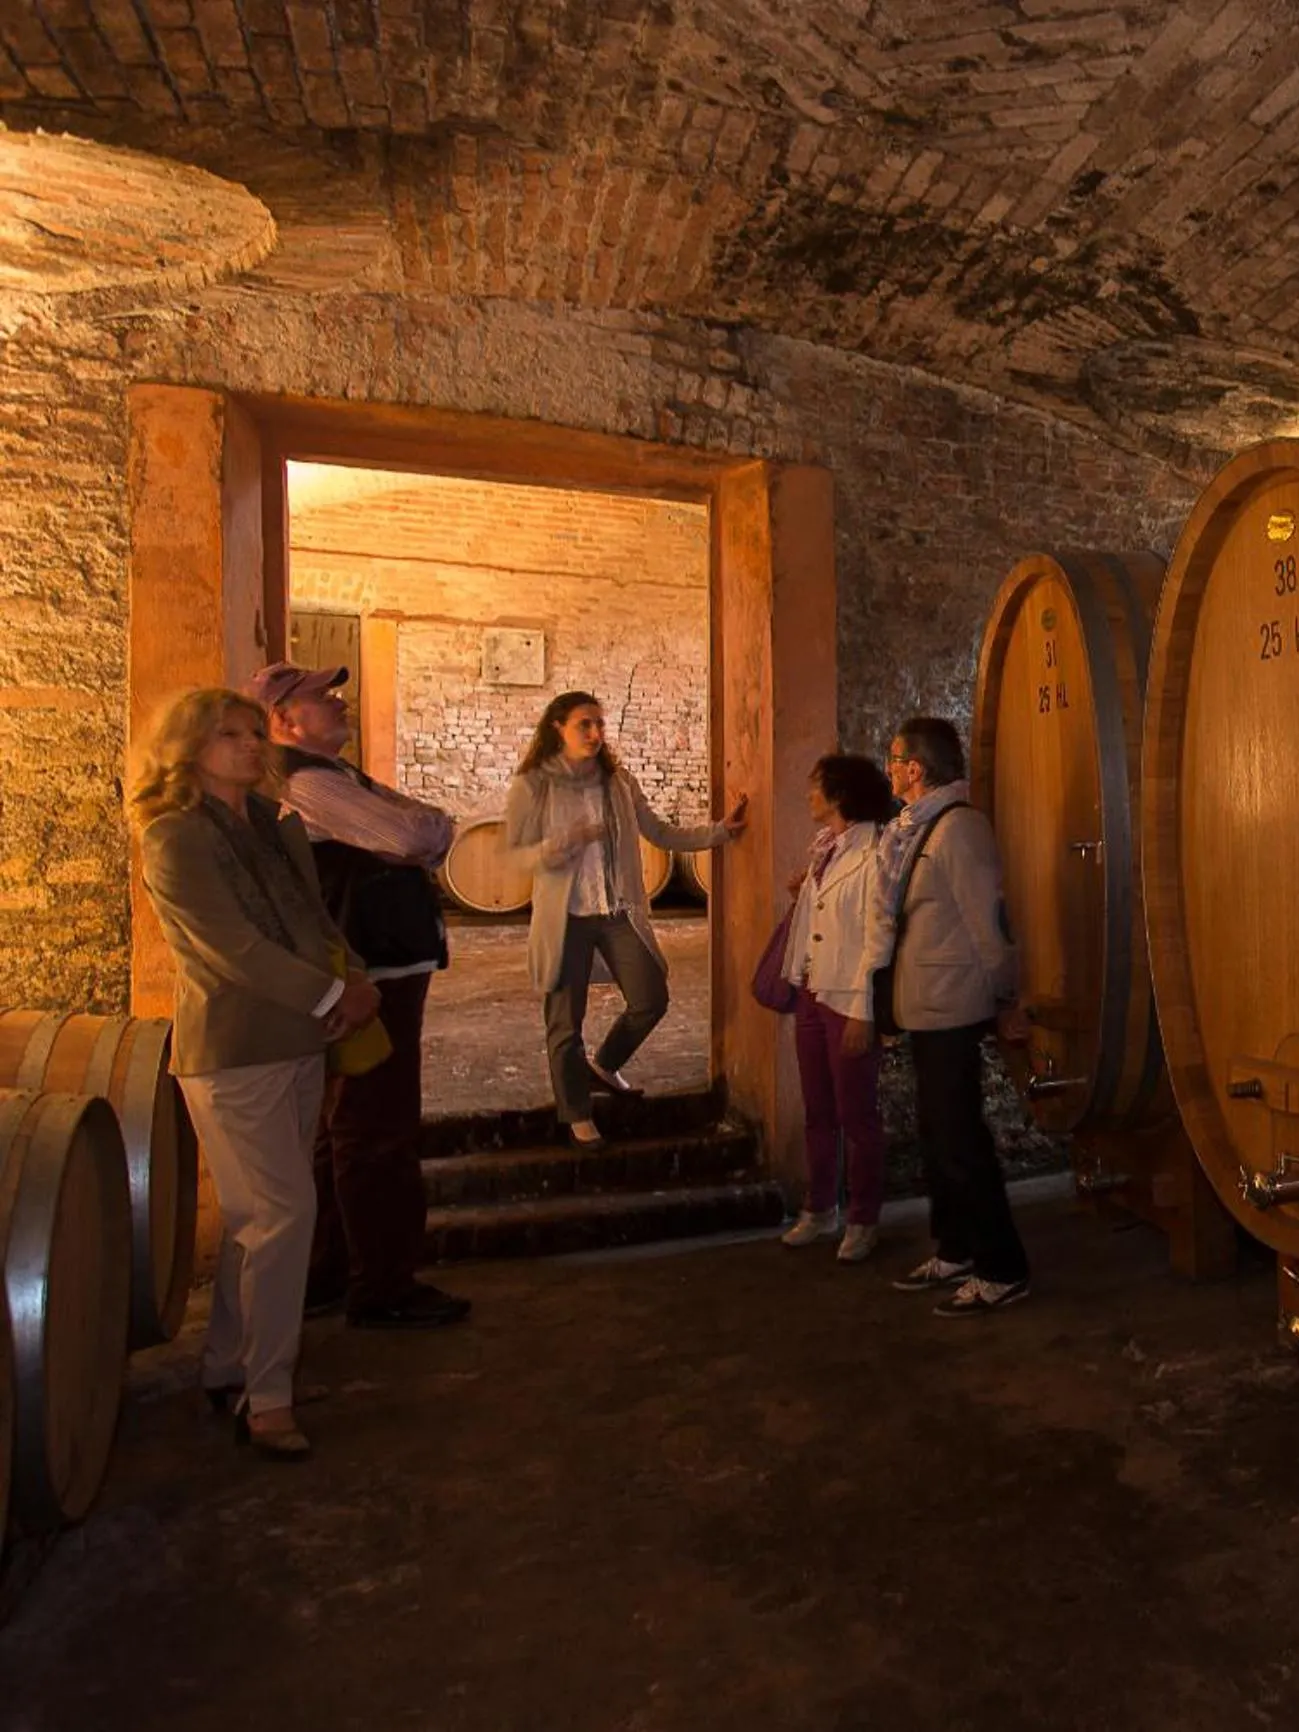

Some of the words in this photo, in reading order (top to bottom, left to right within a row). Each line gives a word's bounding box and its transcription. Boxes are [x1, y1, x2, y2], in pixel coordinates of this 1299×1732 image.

[1274, 555, 1297, 596] 38
[1260, 620, 1282, 660] 25
[1039, 685, 1050, 713] 25
[1056, 683, 1069, 709] HL
